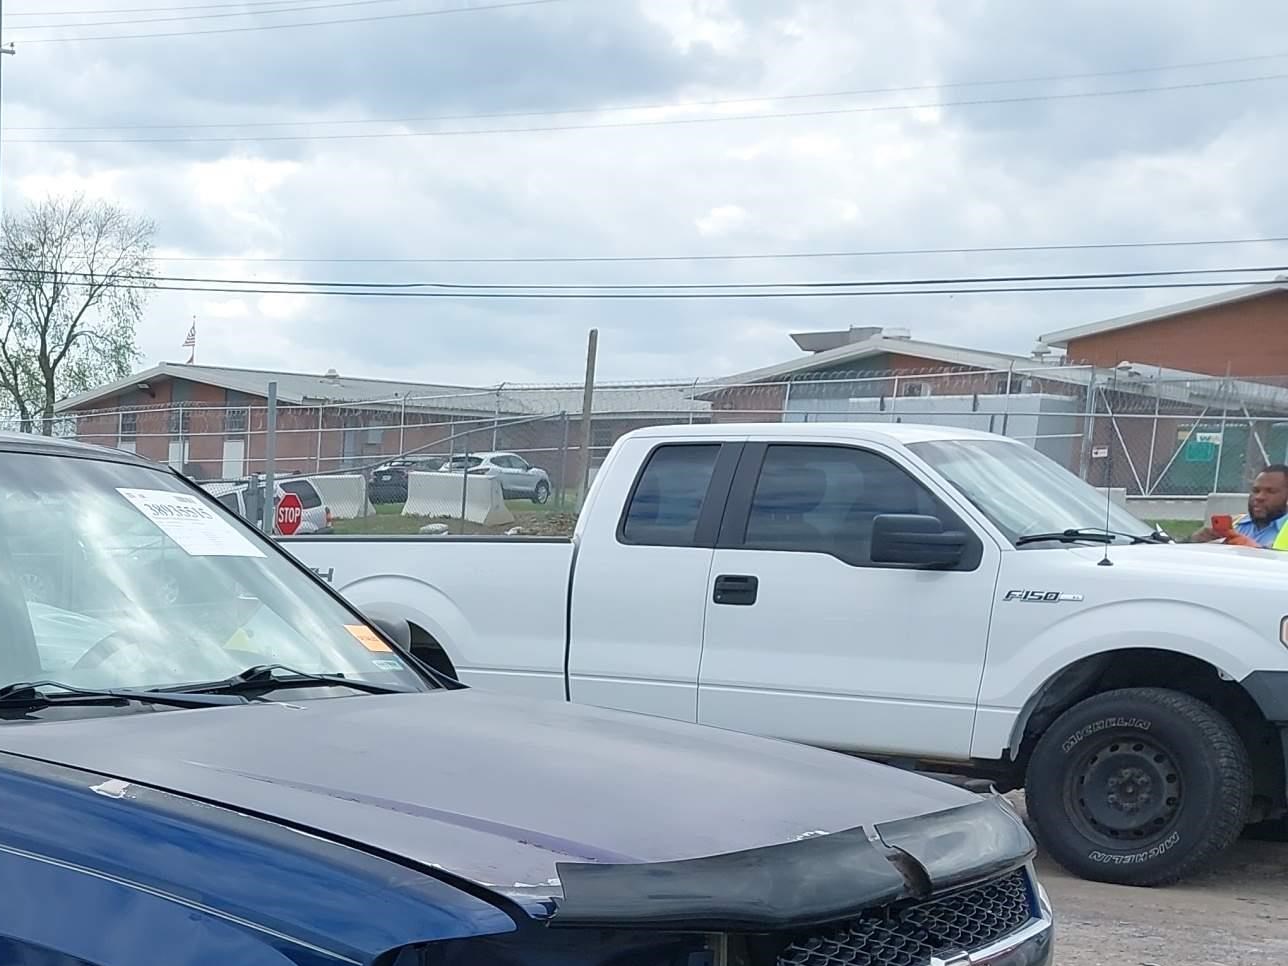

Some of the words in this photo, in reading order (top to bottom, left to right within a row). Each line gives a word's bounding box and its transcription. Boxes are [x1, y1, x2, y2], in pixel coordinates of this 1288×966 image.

[143, 503, 214, 520] 38935515
[278, 507, 301, 523] STOP
[1062, 717, 1152, 753] MICHELIN
[1088, 831, 1180, 865] MICHELIN
